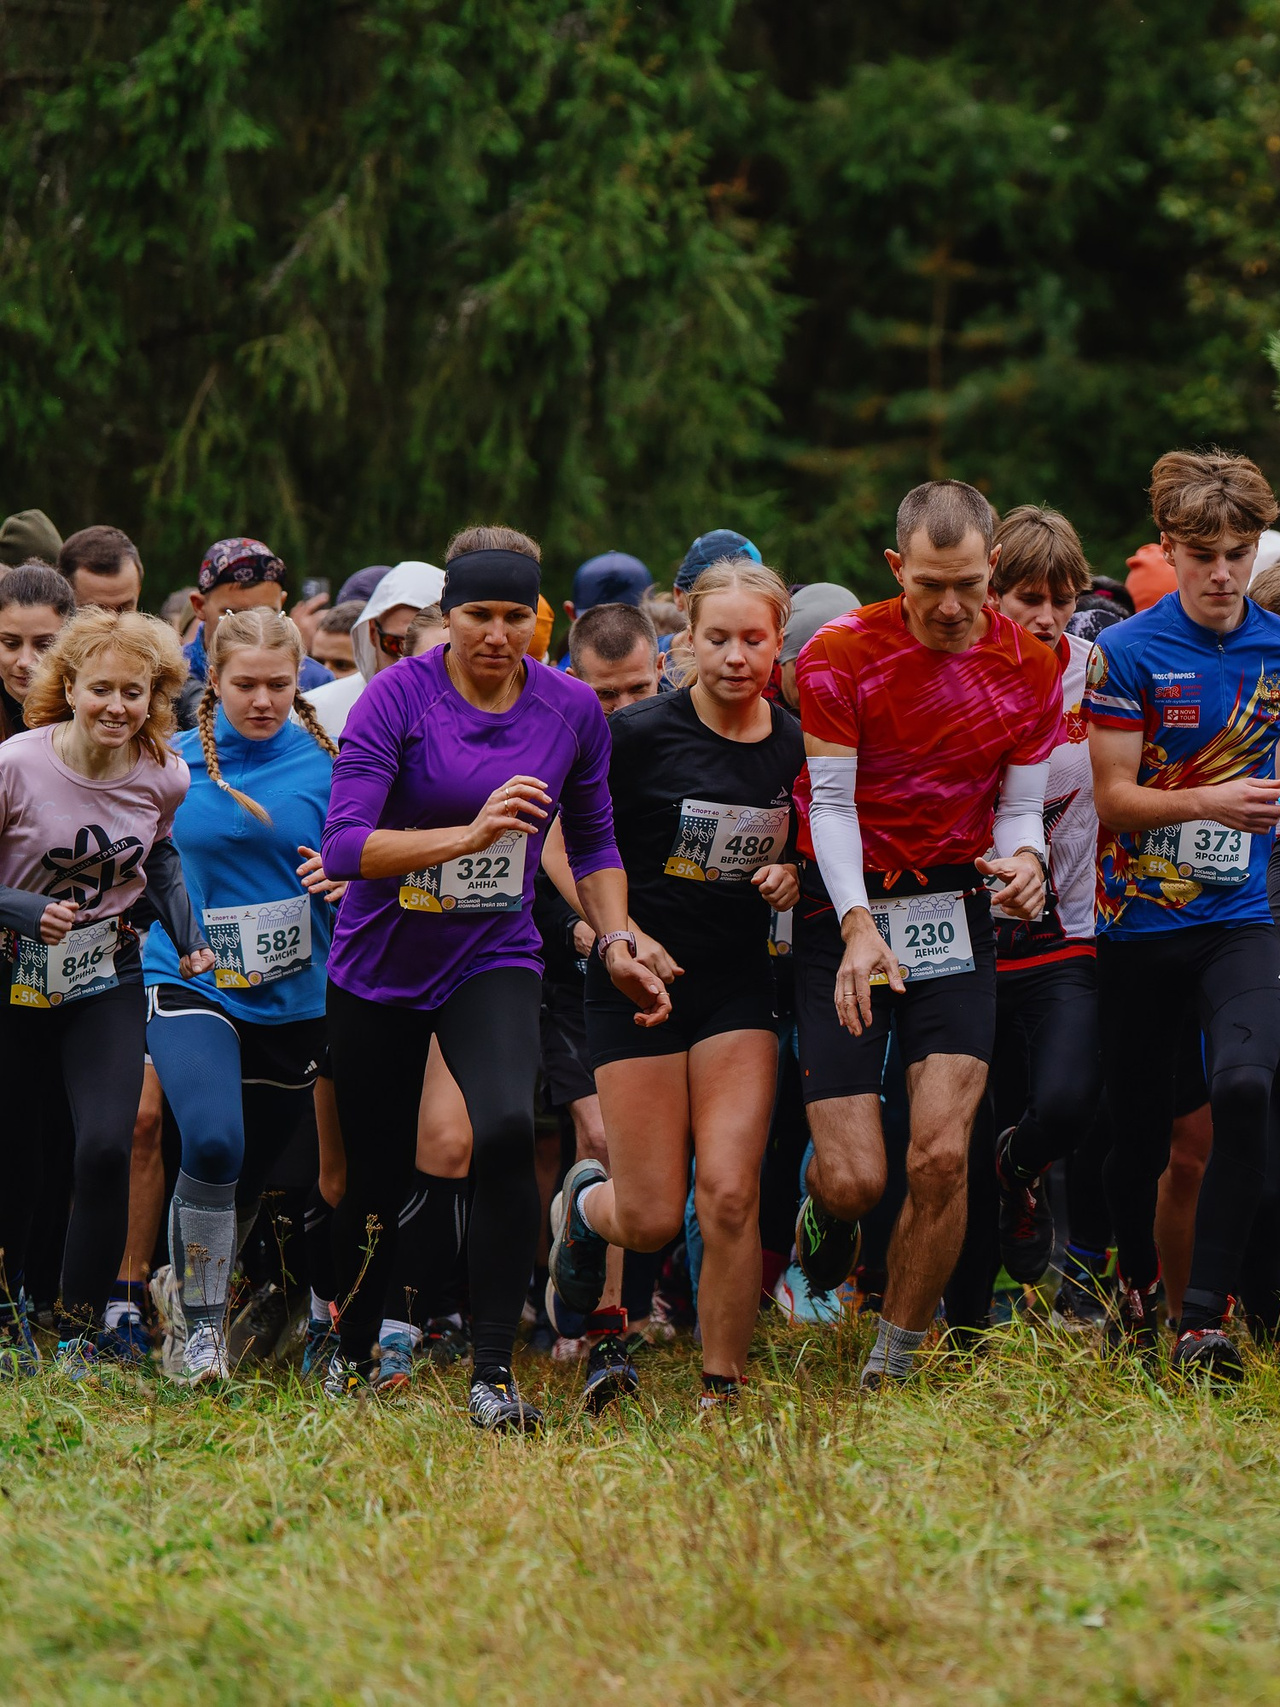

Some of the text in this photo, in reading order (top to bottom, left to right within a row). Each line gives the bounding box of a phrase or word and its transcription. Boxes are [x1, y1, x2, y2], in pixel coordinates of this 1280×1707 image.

[96, 840, 128, 860] ТРЕЙЛ
[725, 835, 774, 856] 480
[1194, 829, 1242, 852] 373
[720, 856, 769, 865] ВЕРОНИКА
[1194, 851, 1240, 863] ЯРОСЛАВ
[457, 857, 510, 880] 322
[467, 880, 498, 890] АННА
[256, 926, 300, 955] 582
[904, 921, 955, 948] 230
[62, 946, 104, 977] 846
[263, 947, 297, 964] ТАИСИЯ
[914, 946, 949, 958] ДЕНИС
[69, 967, 97, 984] ИРИНА
